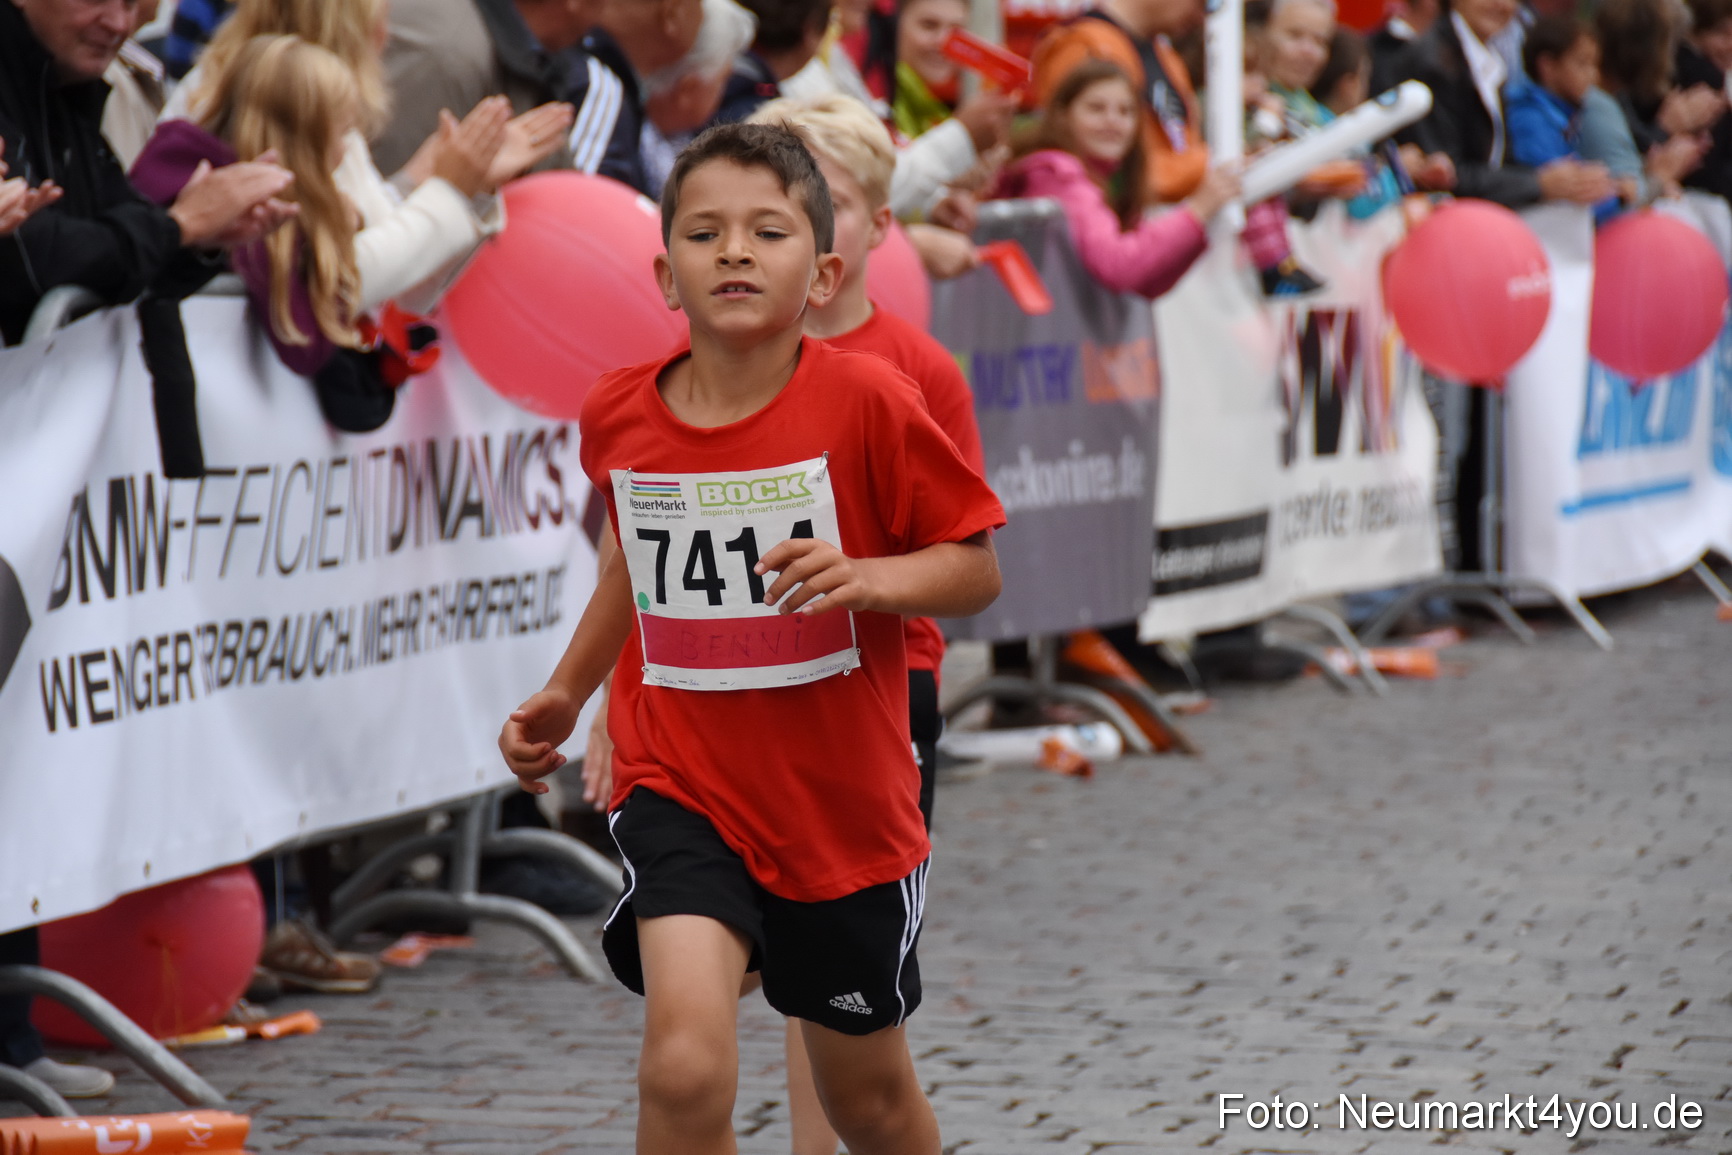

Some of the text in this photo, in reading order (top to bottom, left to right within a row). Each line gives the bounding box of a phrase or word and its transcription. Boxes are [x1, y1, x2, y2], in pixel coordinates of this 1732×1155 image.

[697, 472, 812, 507] BOCK
[629, 497, 687, 511] NeuerMarkt
[700, 498, 815, 517] inspired by smart concepts
[829, 999, 873, 1015] adidas
